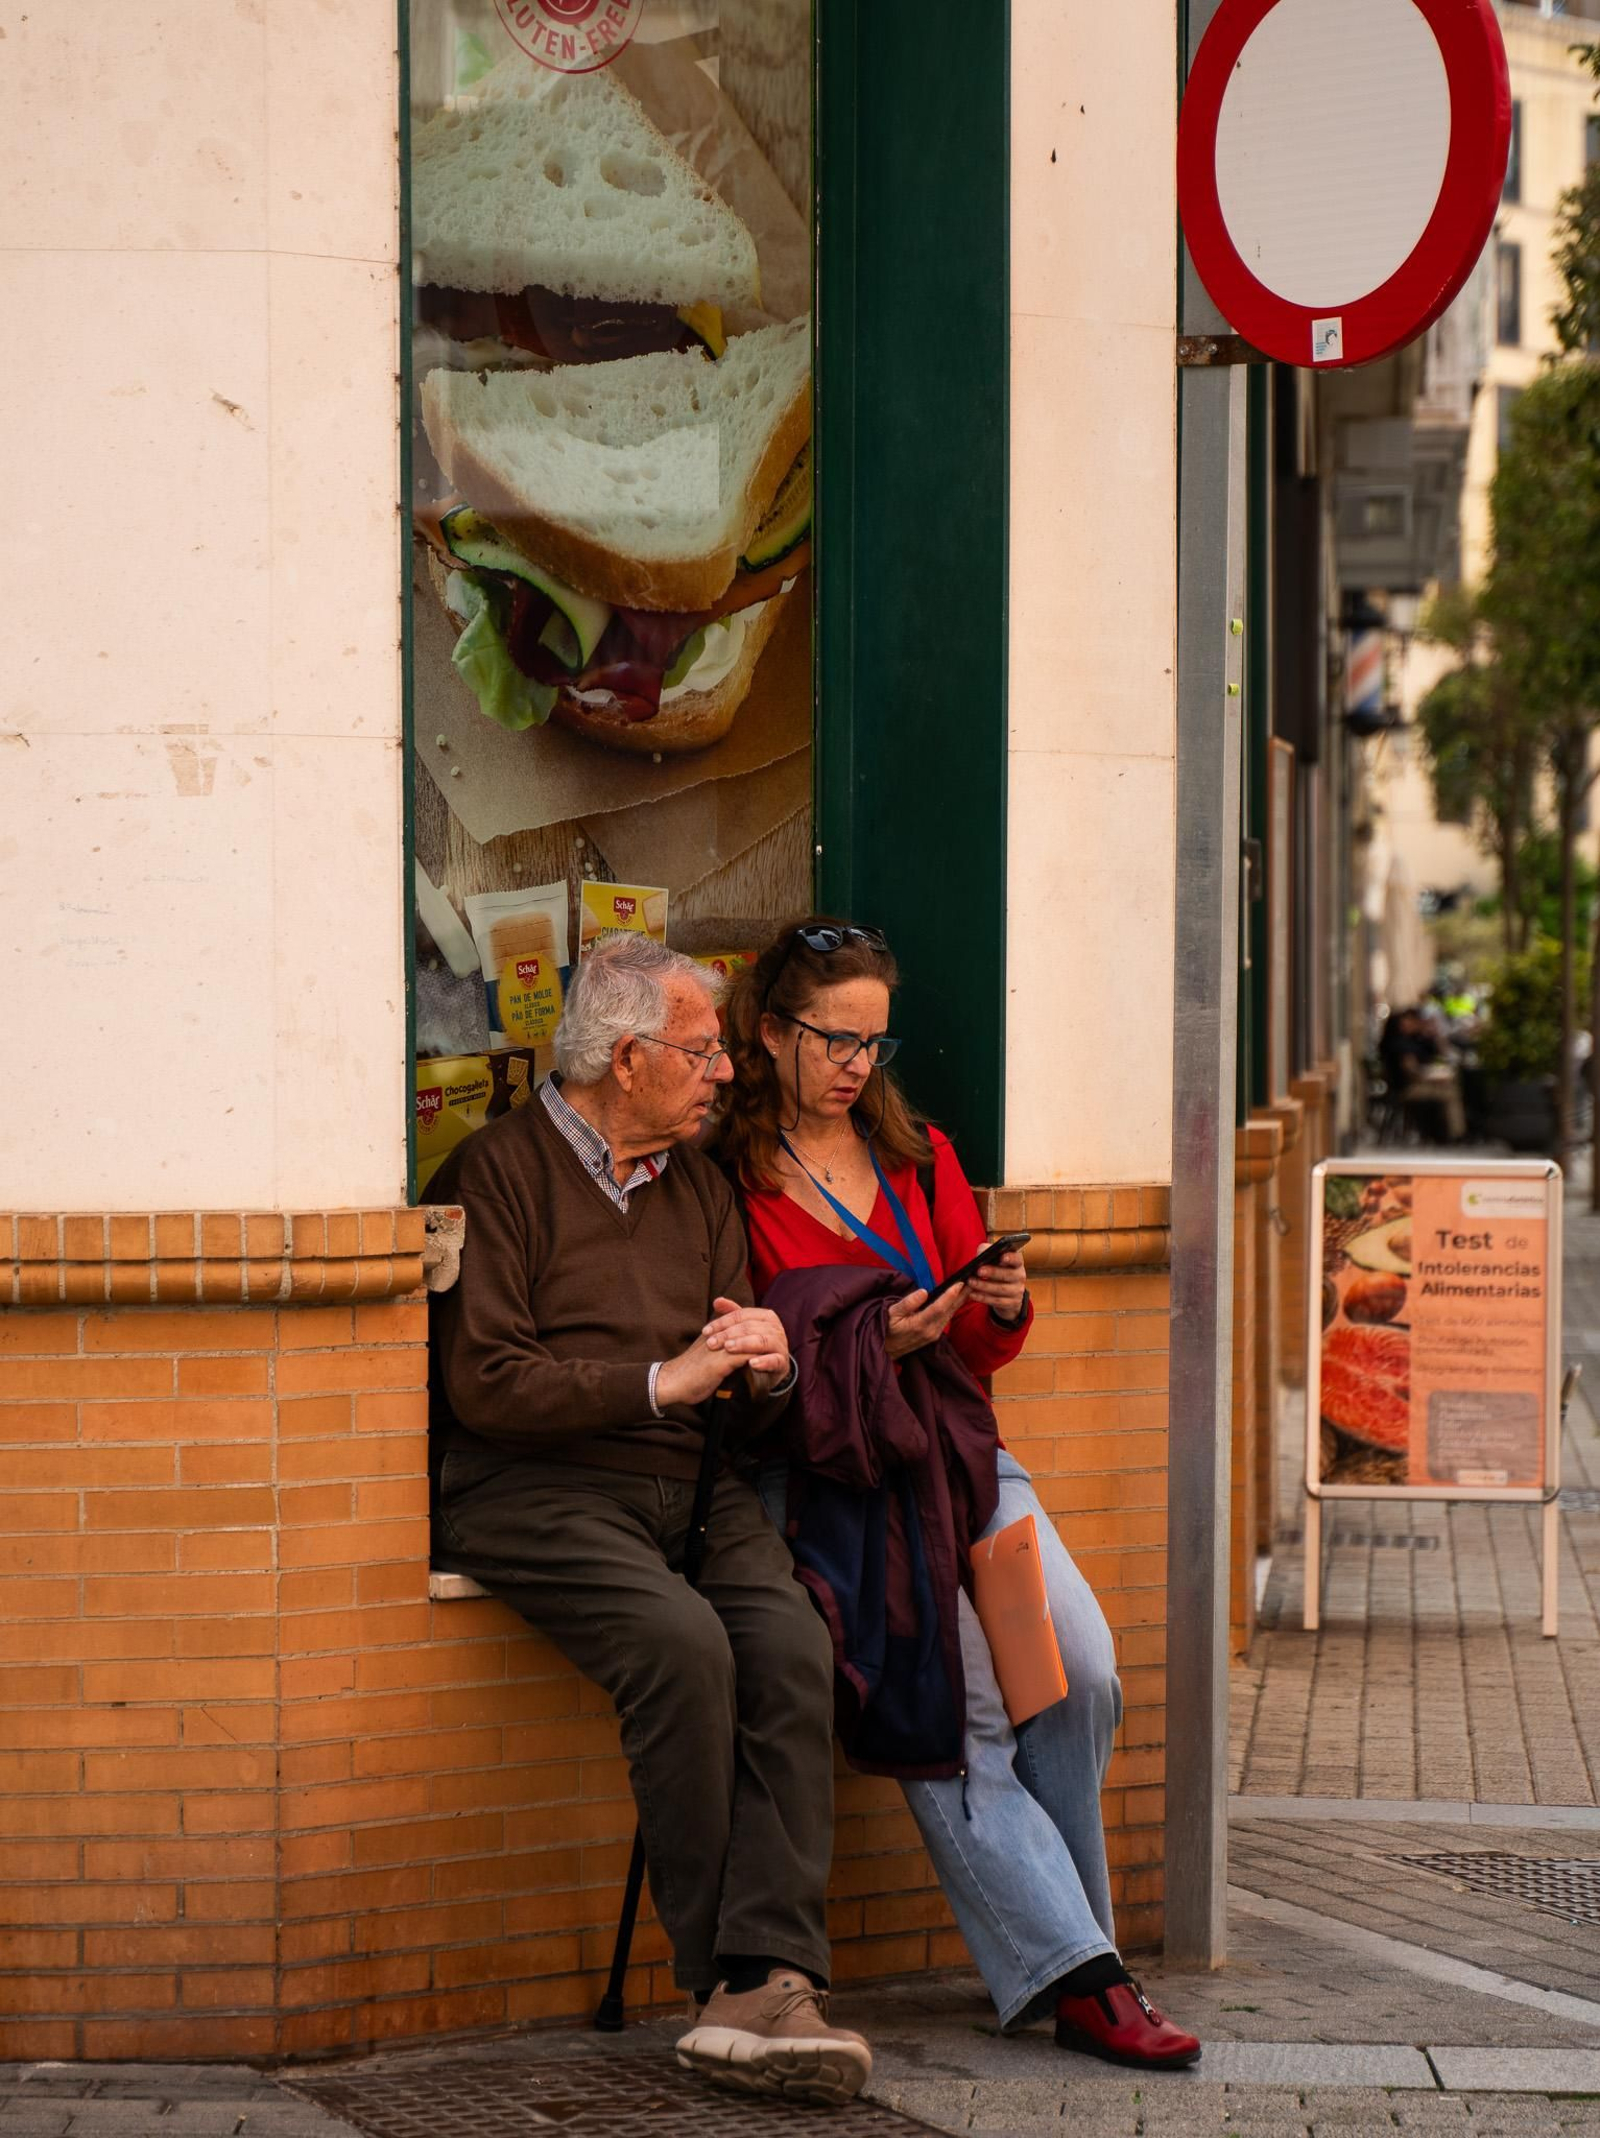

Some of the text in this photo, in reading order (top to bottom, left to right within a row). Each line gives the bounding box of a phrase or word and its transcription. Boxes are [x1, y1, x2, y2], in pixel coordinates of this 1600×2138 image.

[509, 988, 552, 1004] PAN DE MOLDE
[525, 1009, 533, 1018] DE
[535, 1005, 556, 1017] FORMA
[416, 1095, 440, 1111] Schär
[1435, 1230, 1529, 1250] Test de
[1418, 1261, 1541, 1277] Intolerancias
[1420, 1282, 1541, 1298] Alimentarias
